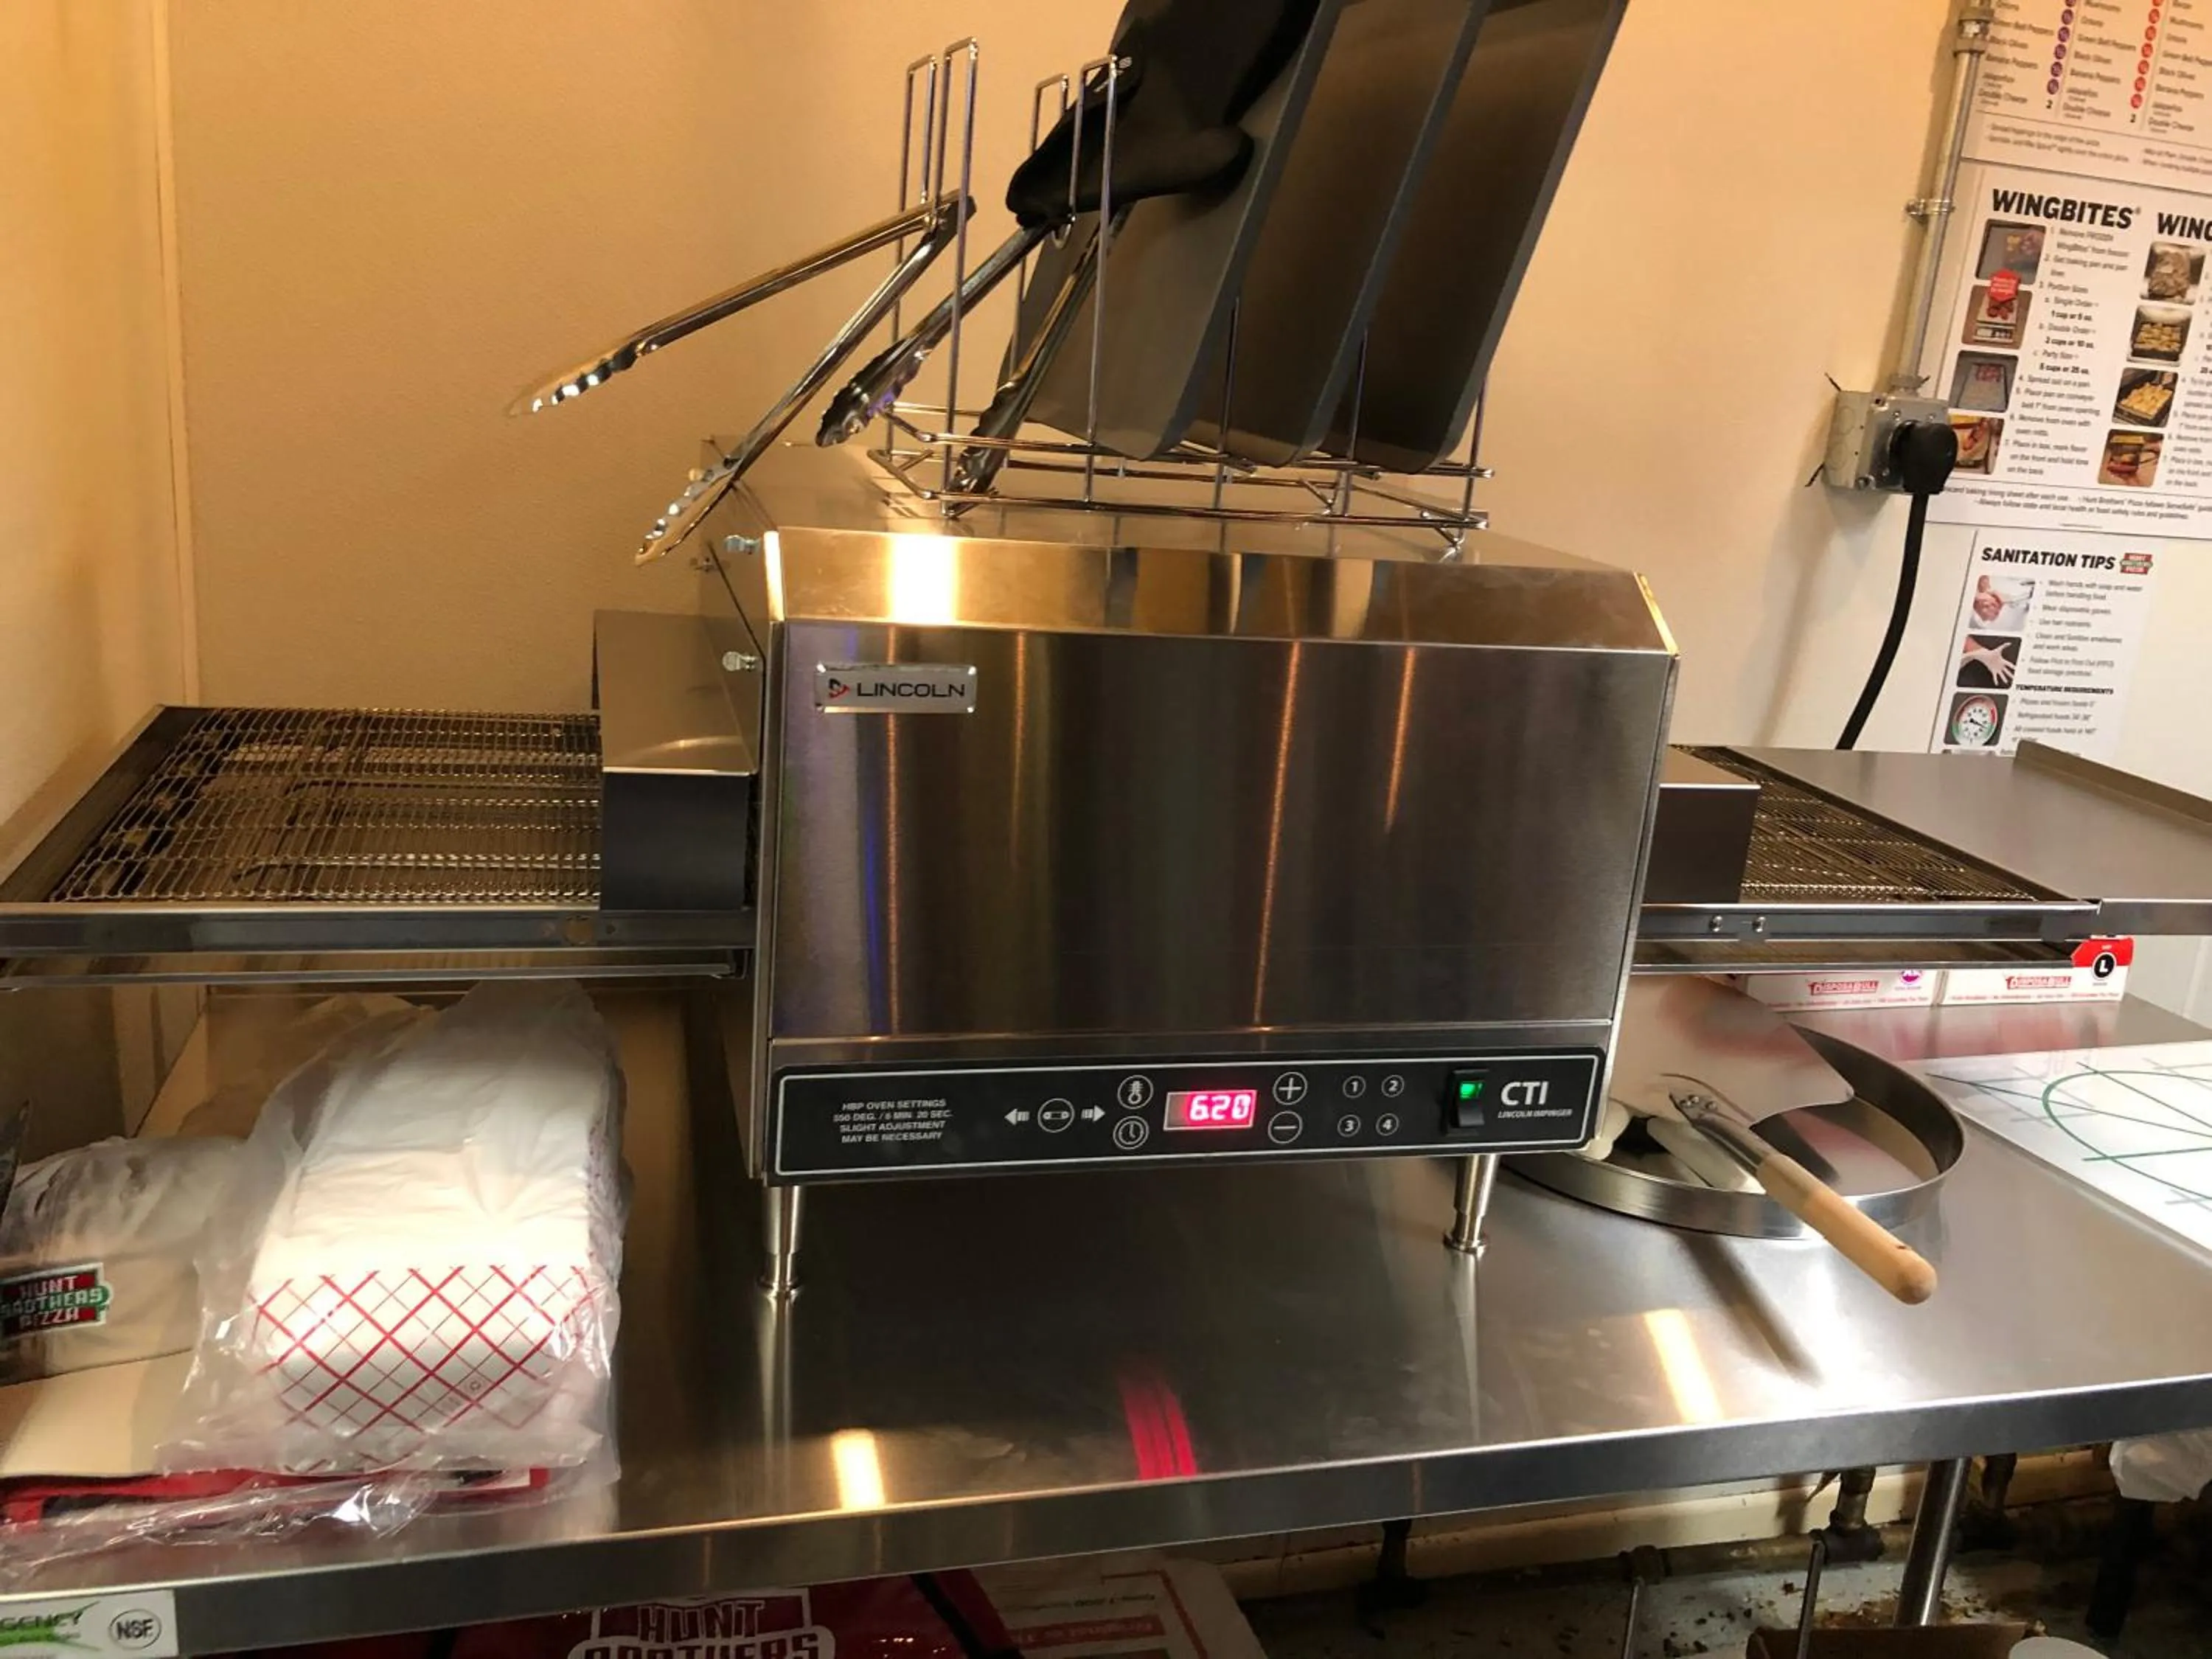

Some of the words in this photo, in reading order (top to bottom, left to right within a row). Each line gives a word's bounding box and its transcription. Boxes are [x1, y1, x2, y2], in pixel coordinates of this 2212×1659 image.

[1981, 546, 2079, 567] SANITATION
[2079, 554, 2116, 571] TIPS
[856, 682, 966, 698] LINCOLN
[2101, 959, 2109, 973] L
[1500, 1081, 1549, 1106] CTI
[866, 1101, 894, 1111] OVEN
[896, 1098, 946, 1109] SETTINGS
[1498, 1110, 1533, 1119] LINCOLN
[1533, 1108, 1573, 1119] IMPINGER
[840, 1122, 877, 1133] SLIGHT
[878, 1120, 946, 1131] ADJUSTMENT
[841, 1134, 863, 1144] MAY
[864, 1133, 880, 1143] BE
[881, 1131, 944, 1142] NECESSARY
[19, 1275, 79, 1299] HUNT
[19, 1307, 80, 1329] PIZZA
[116, 1618, 154, 1641] NSF
[637, 1601, 765, 1641] HUNT
